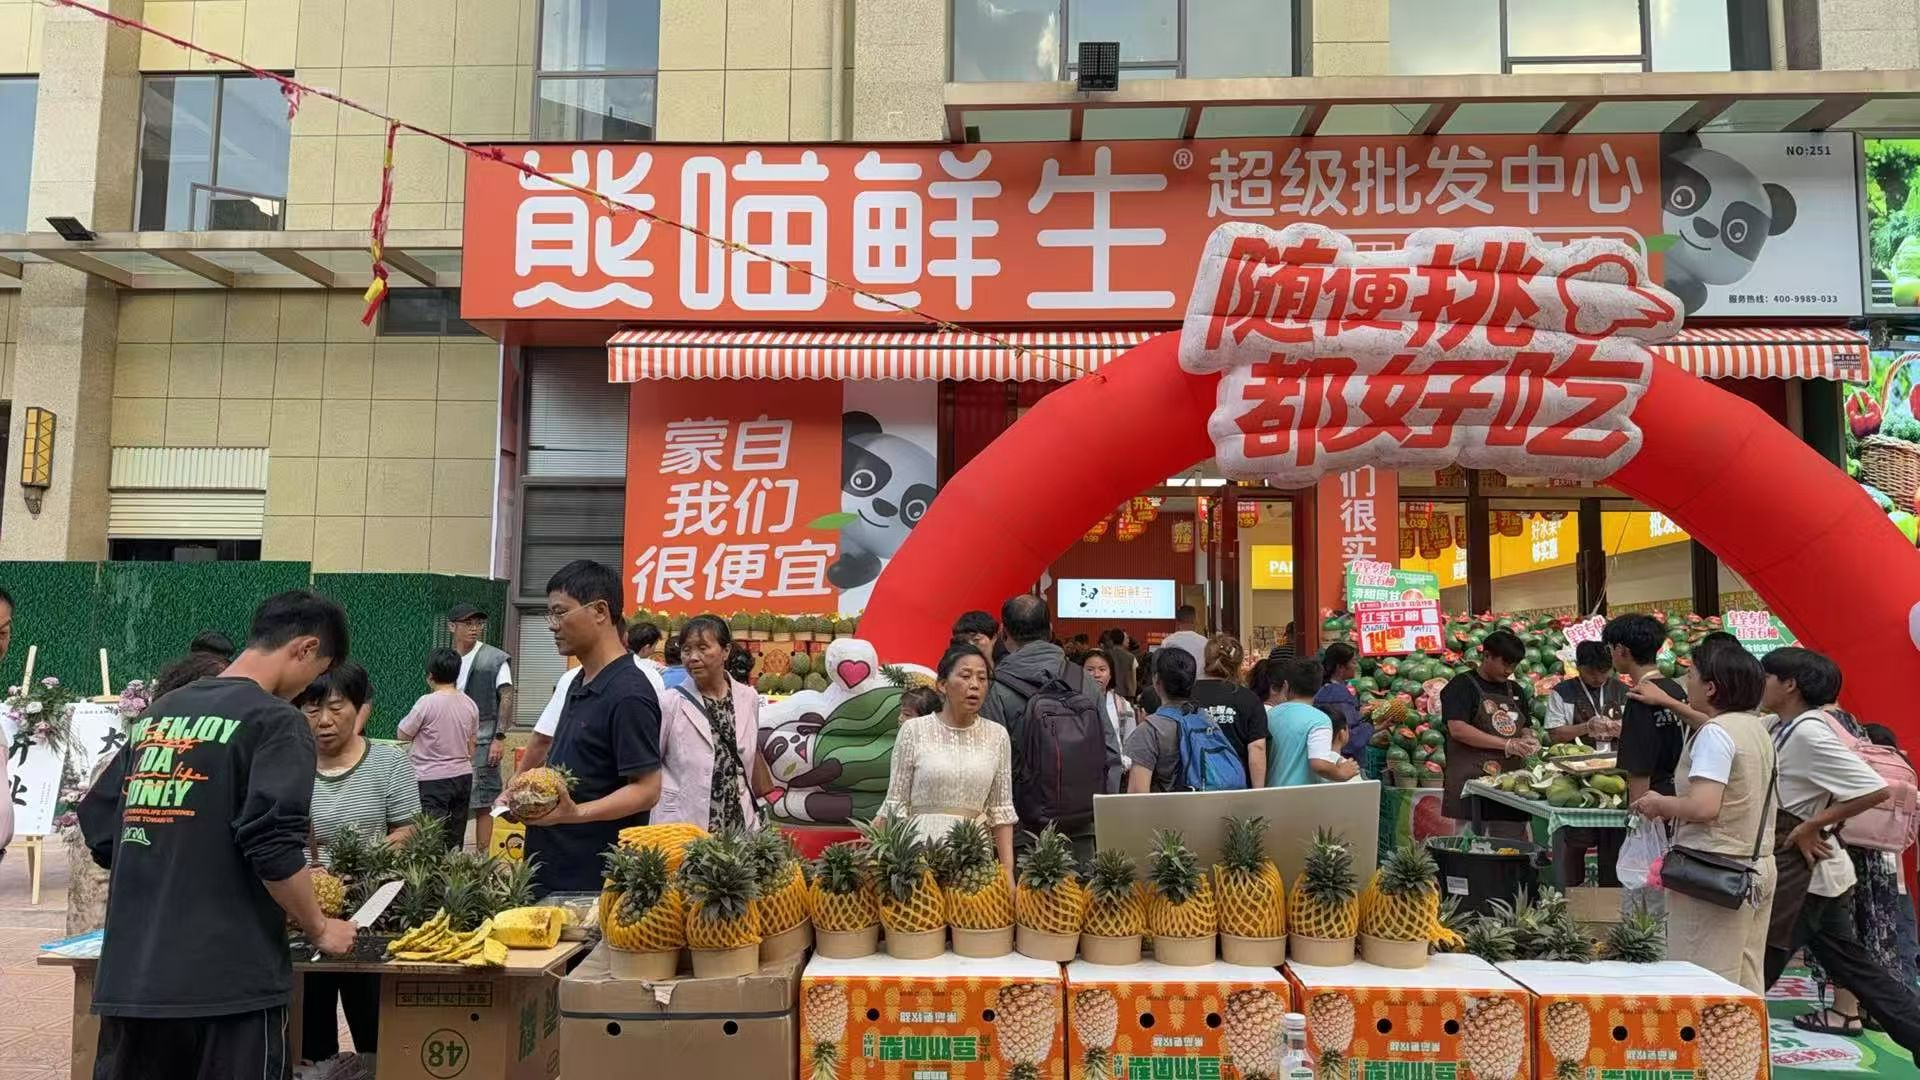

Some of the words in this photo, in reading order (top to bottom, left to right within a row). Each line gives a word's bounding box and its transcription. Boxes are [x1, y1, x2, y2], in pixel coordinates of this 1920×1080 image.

[1206, 142, 1644, 218] 超级批发中心
[1786, 146, 1832, 156] NO:251
[512, 146, 1176, 312] 熊喵鲜生
[1205, 236, 1546, 351] 随便挑
[1240, 344, 1649, 468] 都好吃
[658, 414, 793, 475] 蒙自
[662, 476, 800, 538] 我们
[1340, 464, 1376, 600] 们很实
[631, 538, 837, 604] 很便宜
[139, 746, 174, 773] DA
[125, 779, 194, 807] ONEY
[428, 1040, 464, 1068] 48
